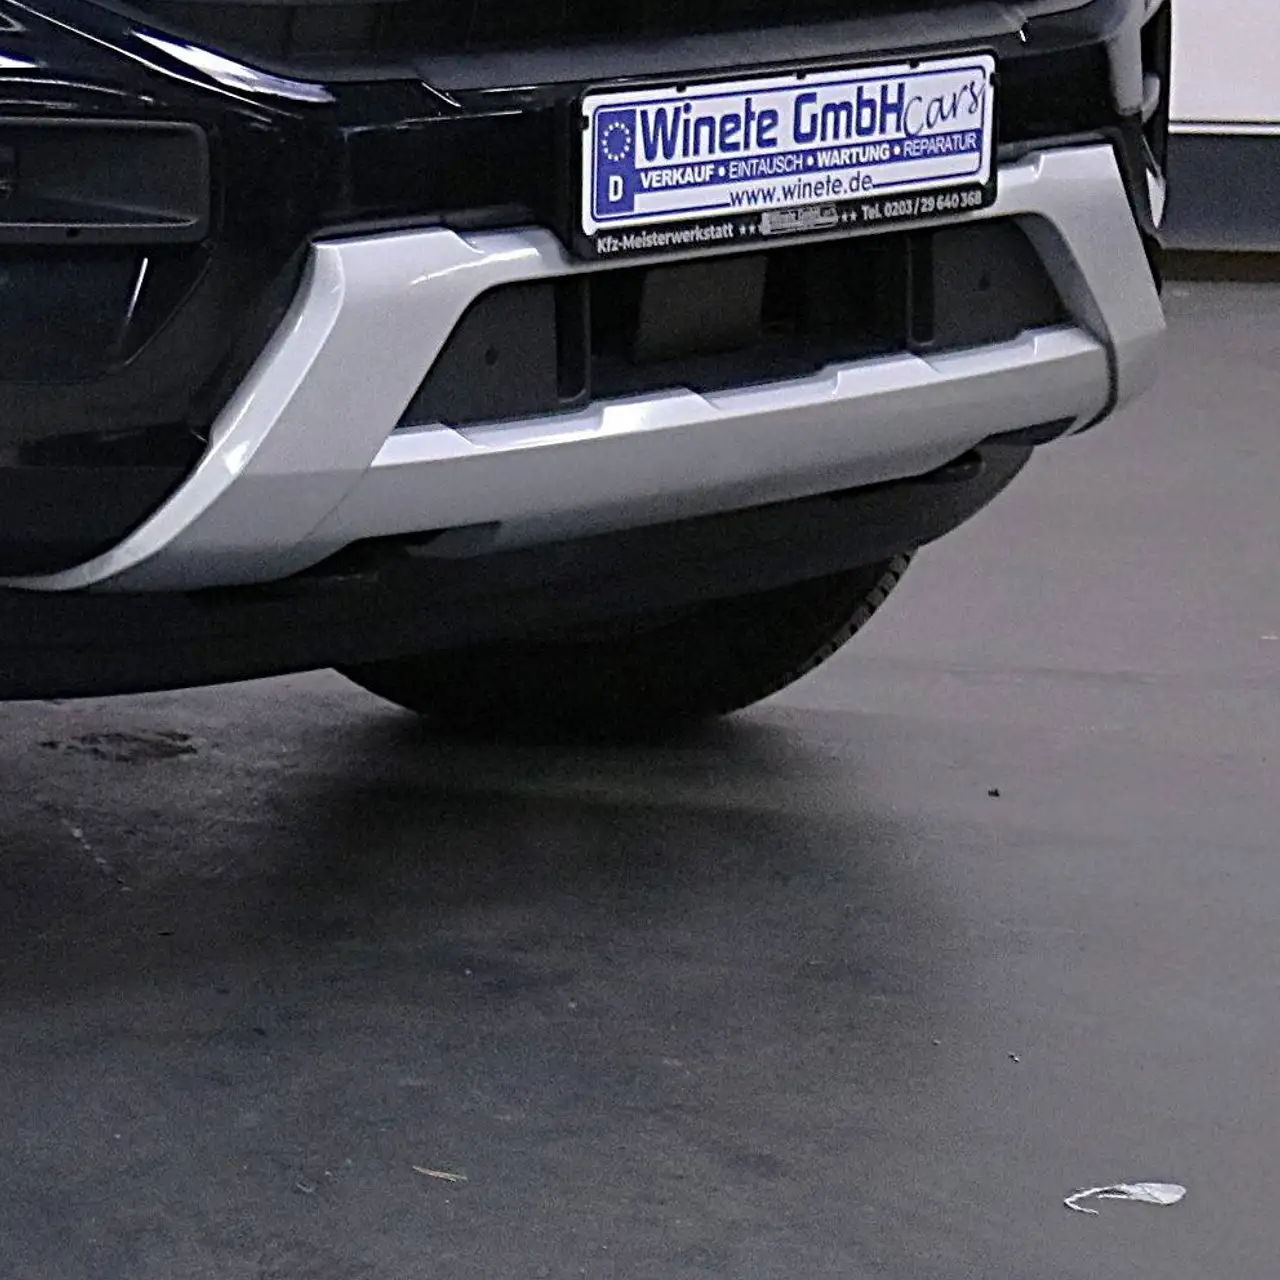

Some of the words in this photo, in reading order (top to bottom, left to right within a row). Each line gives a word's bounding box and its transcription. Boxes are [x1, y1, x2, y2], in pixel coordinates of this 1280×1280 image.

[640, 97, 779, 162] Winete
[793, 82, 905, 144] GmbH
[640, 165, 715, 189] VERKAUF
[728, 154, 804, 179] EINTAUSCH
[817, 144, 889, 168] WARTUNG
[903, 132, 977, 158] REPARATUR
[608, 175, 623, 202] D
[730, 170, 873, 208] www.winete.de
[861, 203, 882, 221] Tel.
[596, 222, 734, 254] Kfz-Meisterwerkstatt
